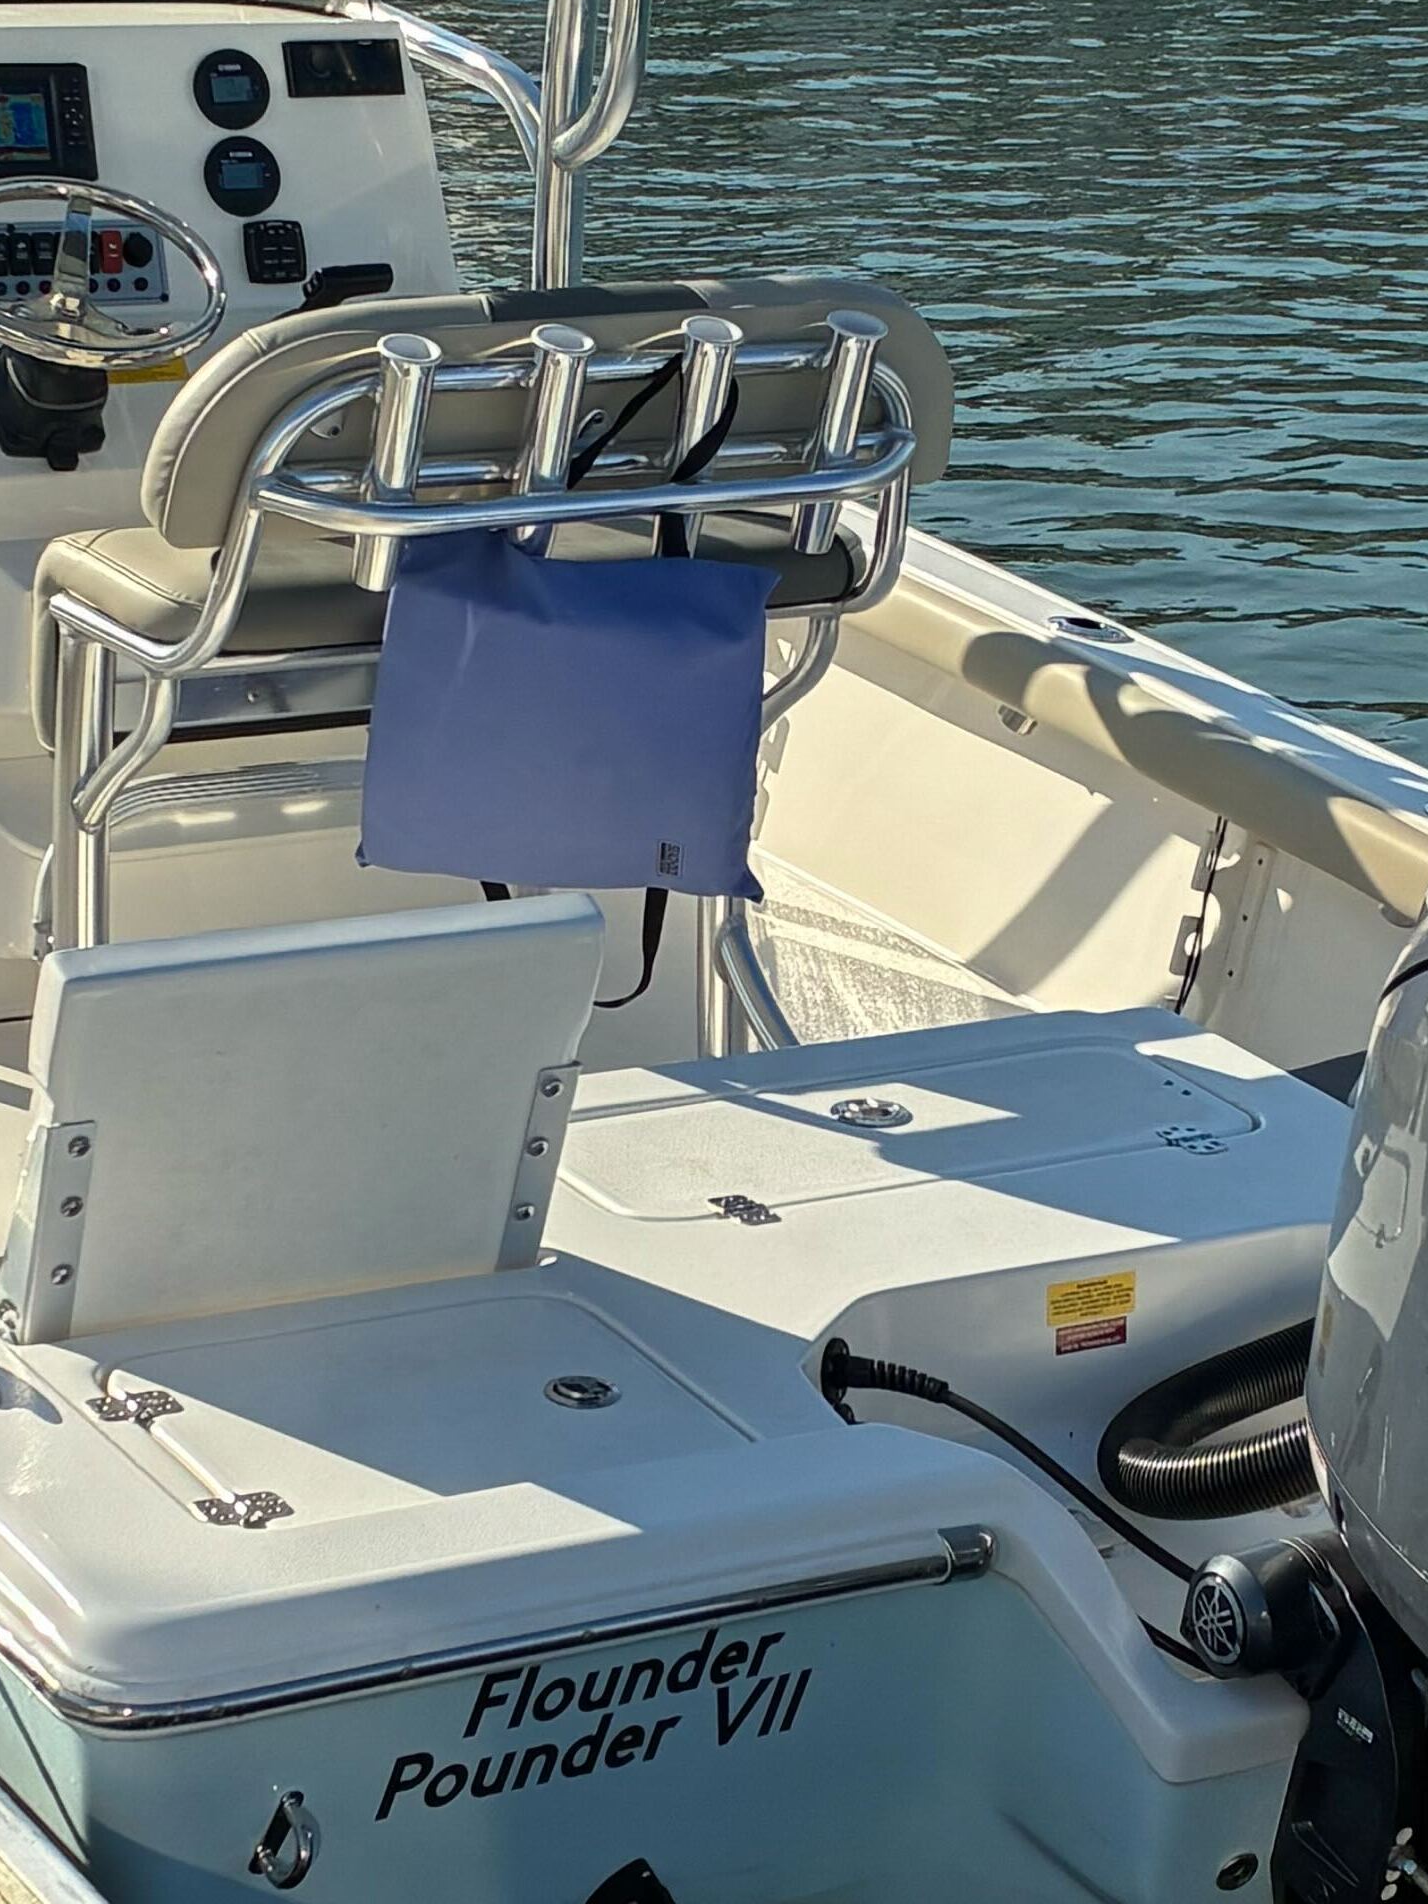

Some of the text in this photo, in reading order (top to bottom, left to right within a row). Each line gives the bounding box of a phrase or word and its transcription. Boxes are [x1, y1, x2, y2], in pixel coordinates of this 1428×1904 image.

[374, 1668, 813, 1822] Pounder VII
[462, 1628, 785, 1739] Flounder
